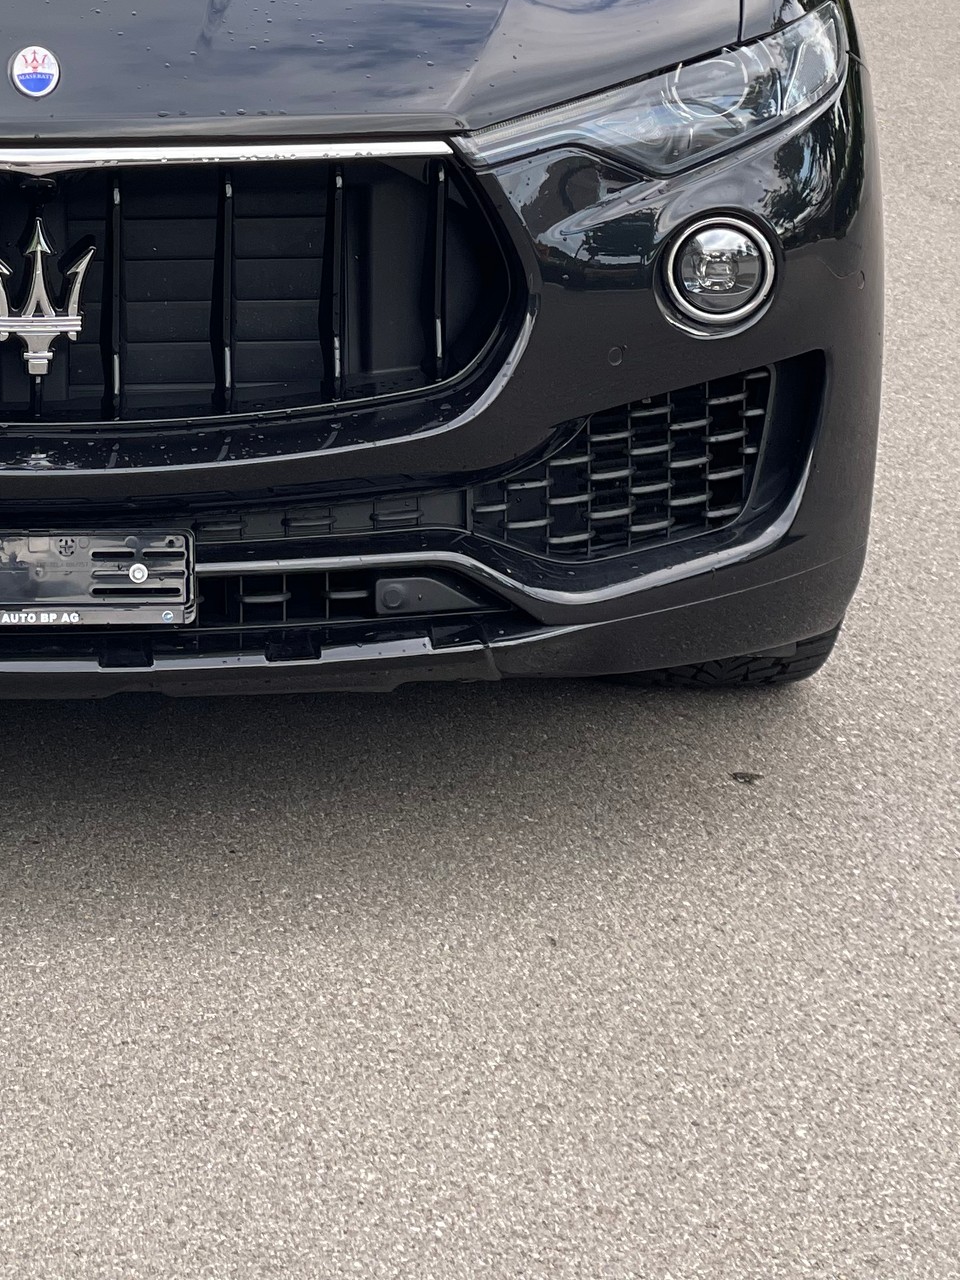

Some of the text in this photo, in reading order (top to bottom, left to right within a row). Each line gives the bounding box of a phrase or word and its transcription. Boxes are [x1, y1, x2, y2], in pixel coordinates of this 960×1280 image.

[1, 612, 80, 623] AUTO BP AG
